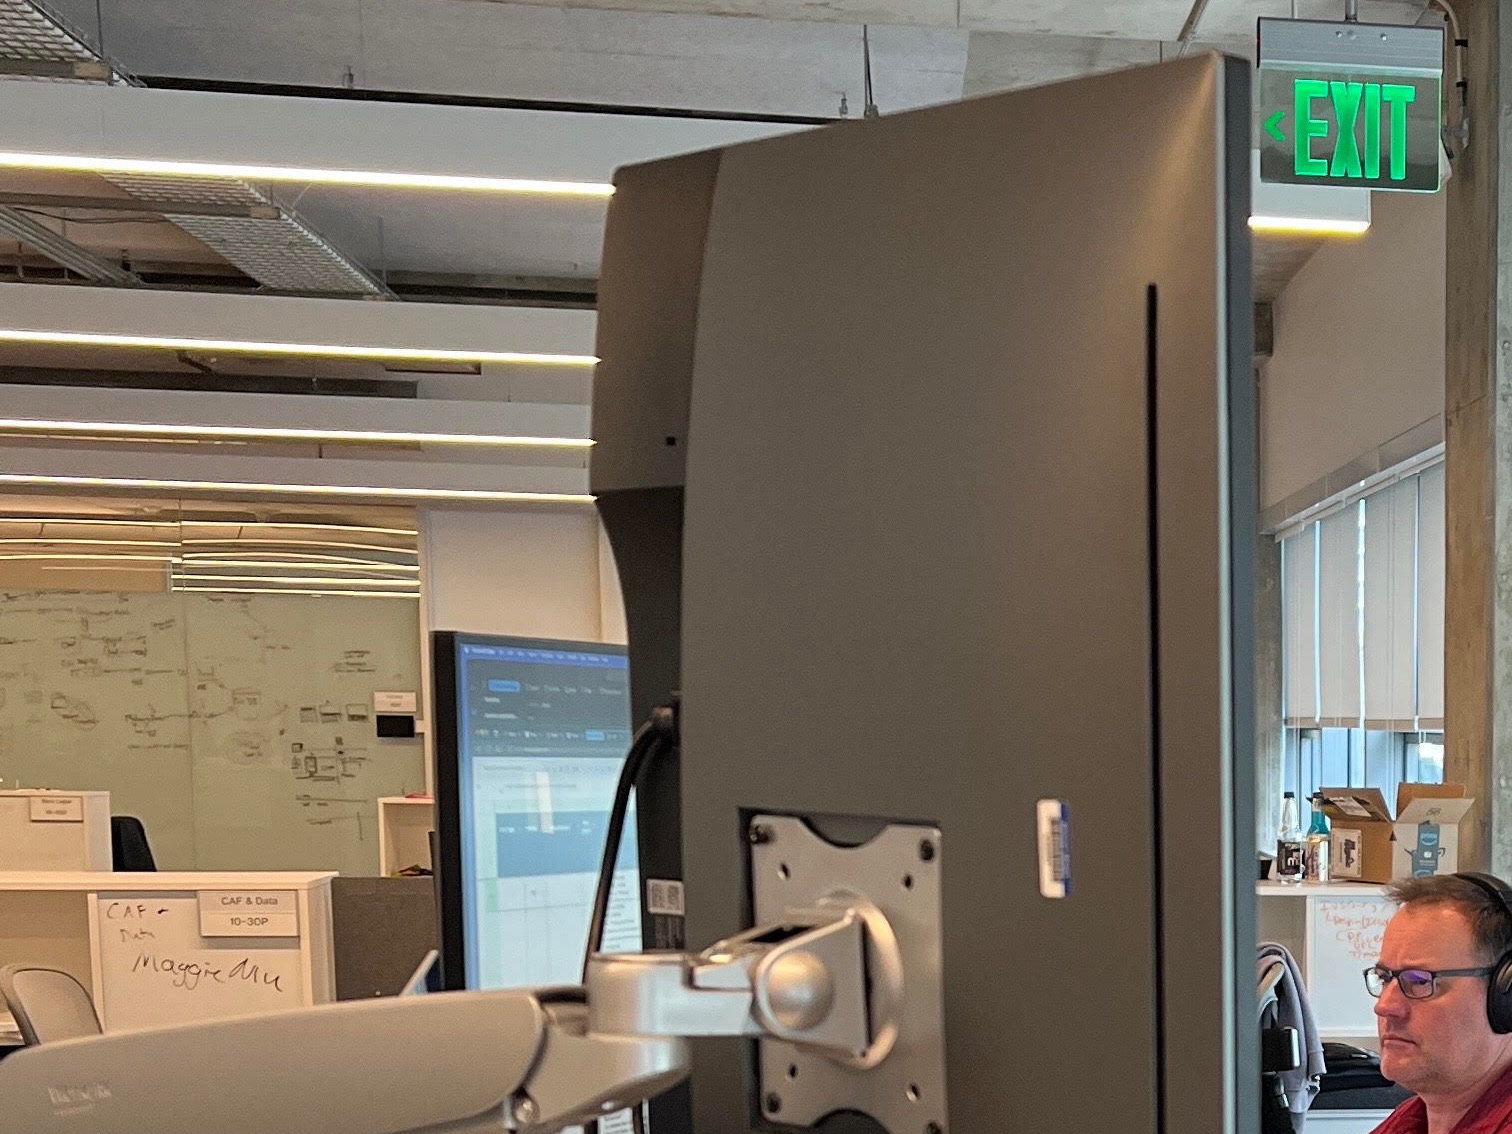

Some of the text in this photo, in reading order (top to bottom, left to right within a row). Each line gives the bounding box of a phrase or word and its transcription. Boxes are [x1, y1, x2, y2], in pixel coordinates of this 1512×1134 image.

[1294, 78, 1416, 181] EXIT
[221, 896, 279, 906] CAF & Data
[106, 902, 146, 919] CAF
[230, 917, 269, 926] 10-30P
[132, 953, 225, 990] Maggie
